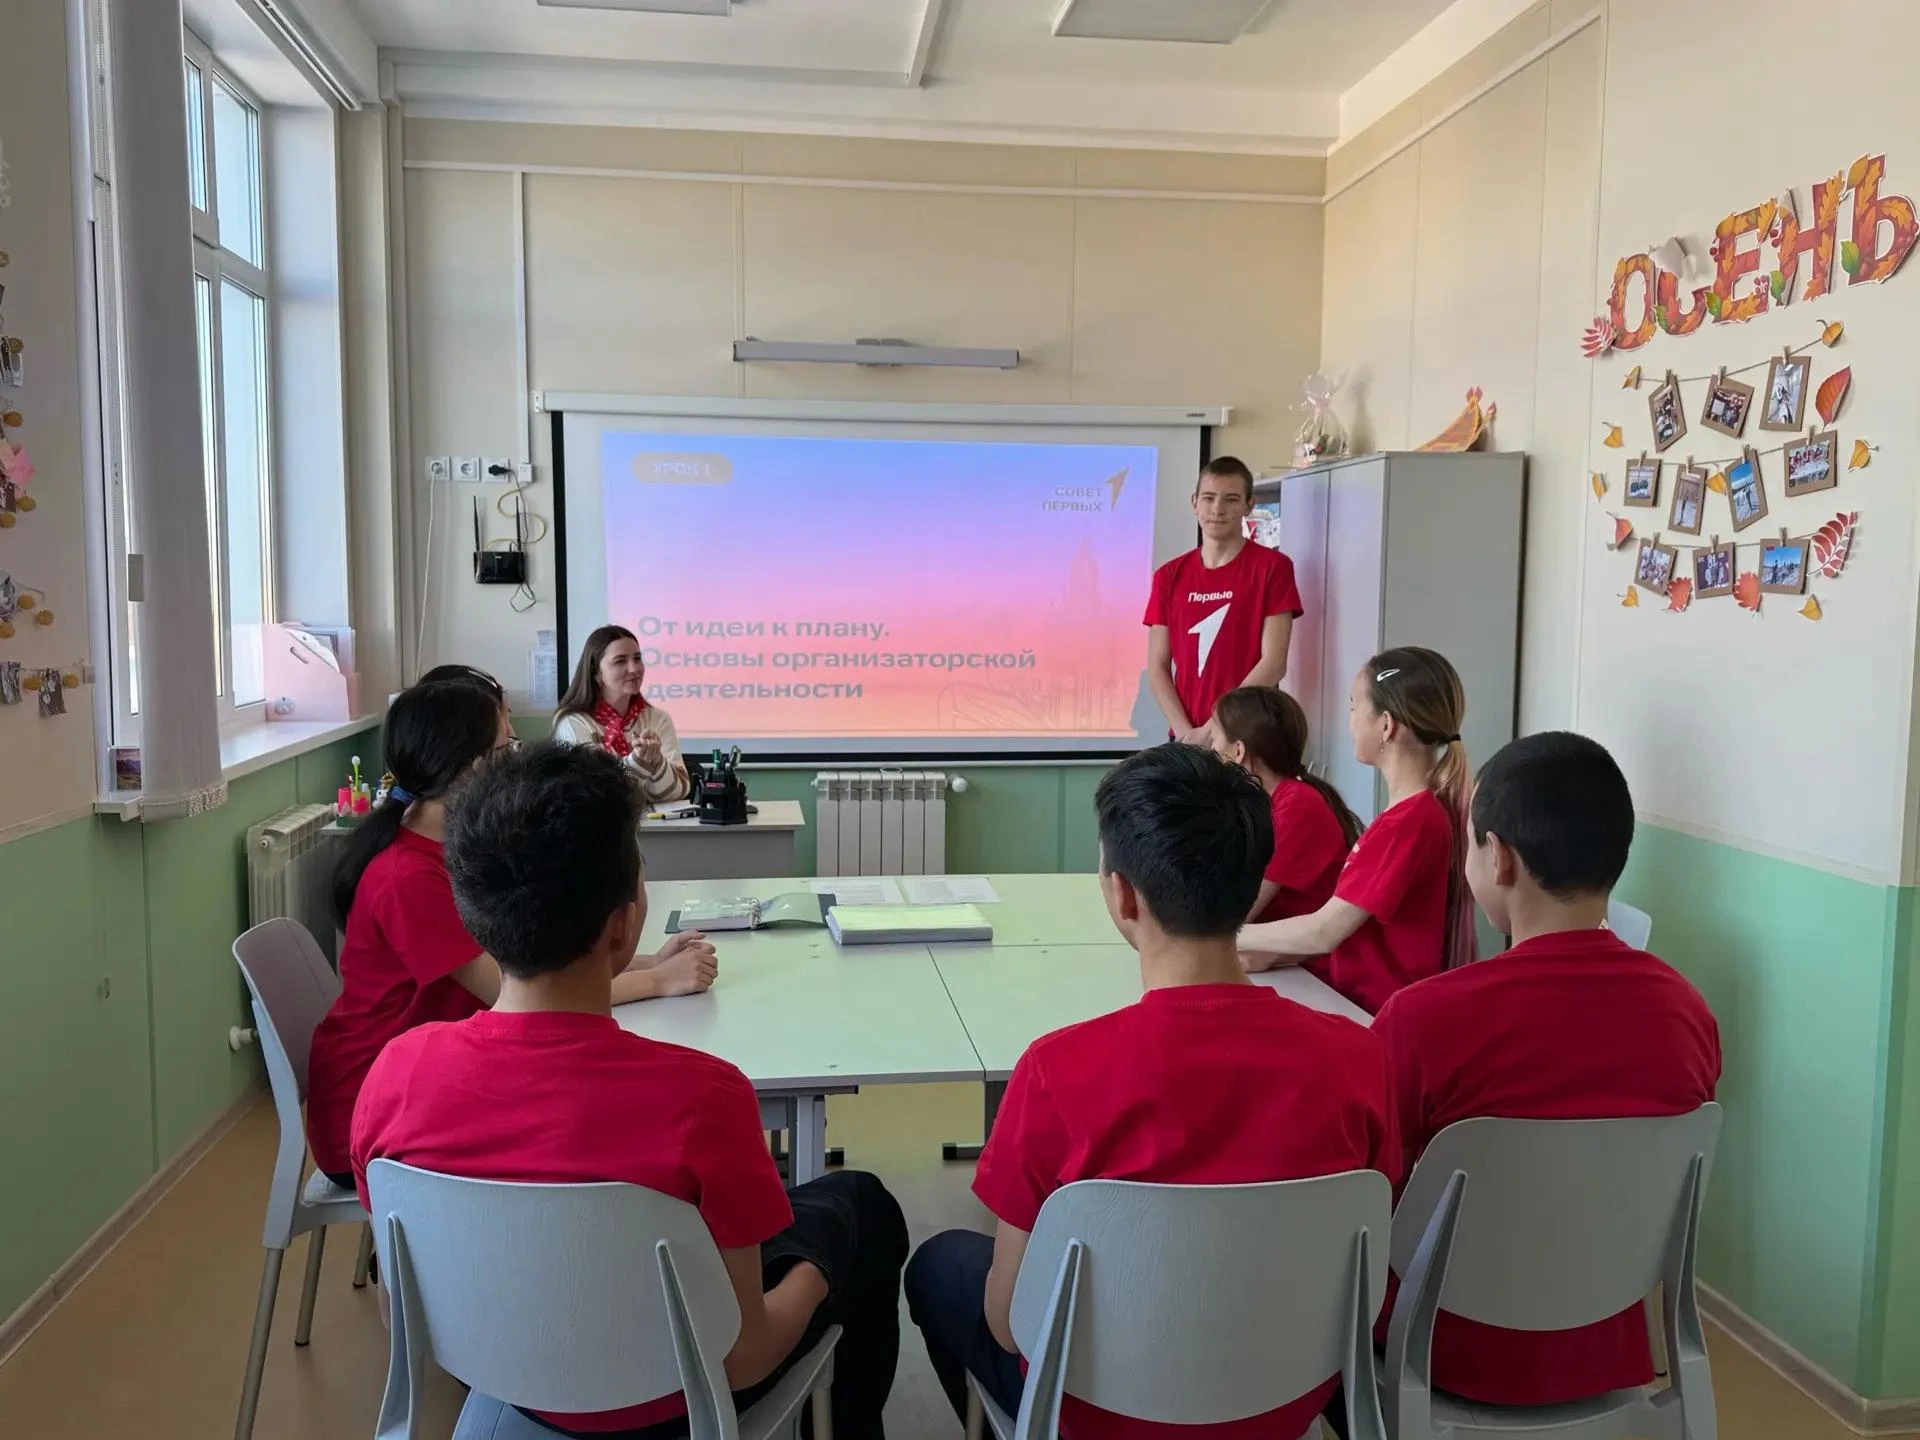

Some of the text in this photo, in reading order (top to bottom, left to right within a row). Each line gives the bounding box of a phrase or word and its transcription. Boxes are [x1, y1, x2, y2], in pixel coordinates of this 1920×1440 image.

[1608, 153, 1920, 351] ОСЕНЬ
[652, 462, 699, 476] УРОК
[1054, 486, 1104, 498] СОВЕТ
[1042, 500, 1102, 513] ПЕРВЫХ
[1188, 590, 1233, 604] Первые
[638, 616, 890, 641] От идеи к плану.
[641, 647, 1036, 672] Основы организаторской
[645, 682, 863, 701] деятельности
